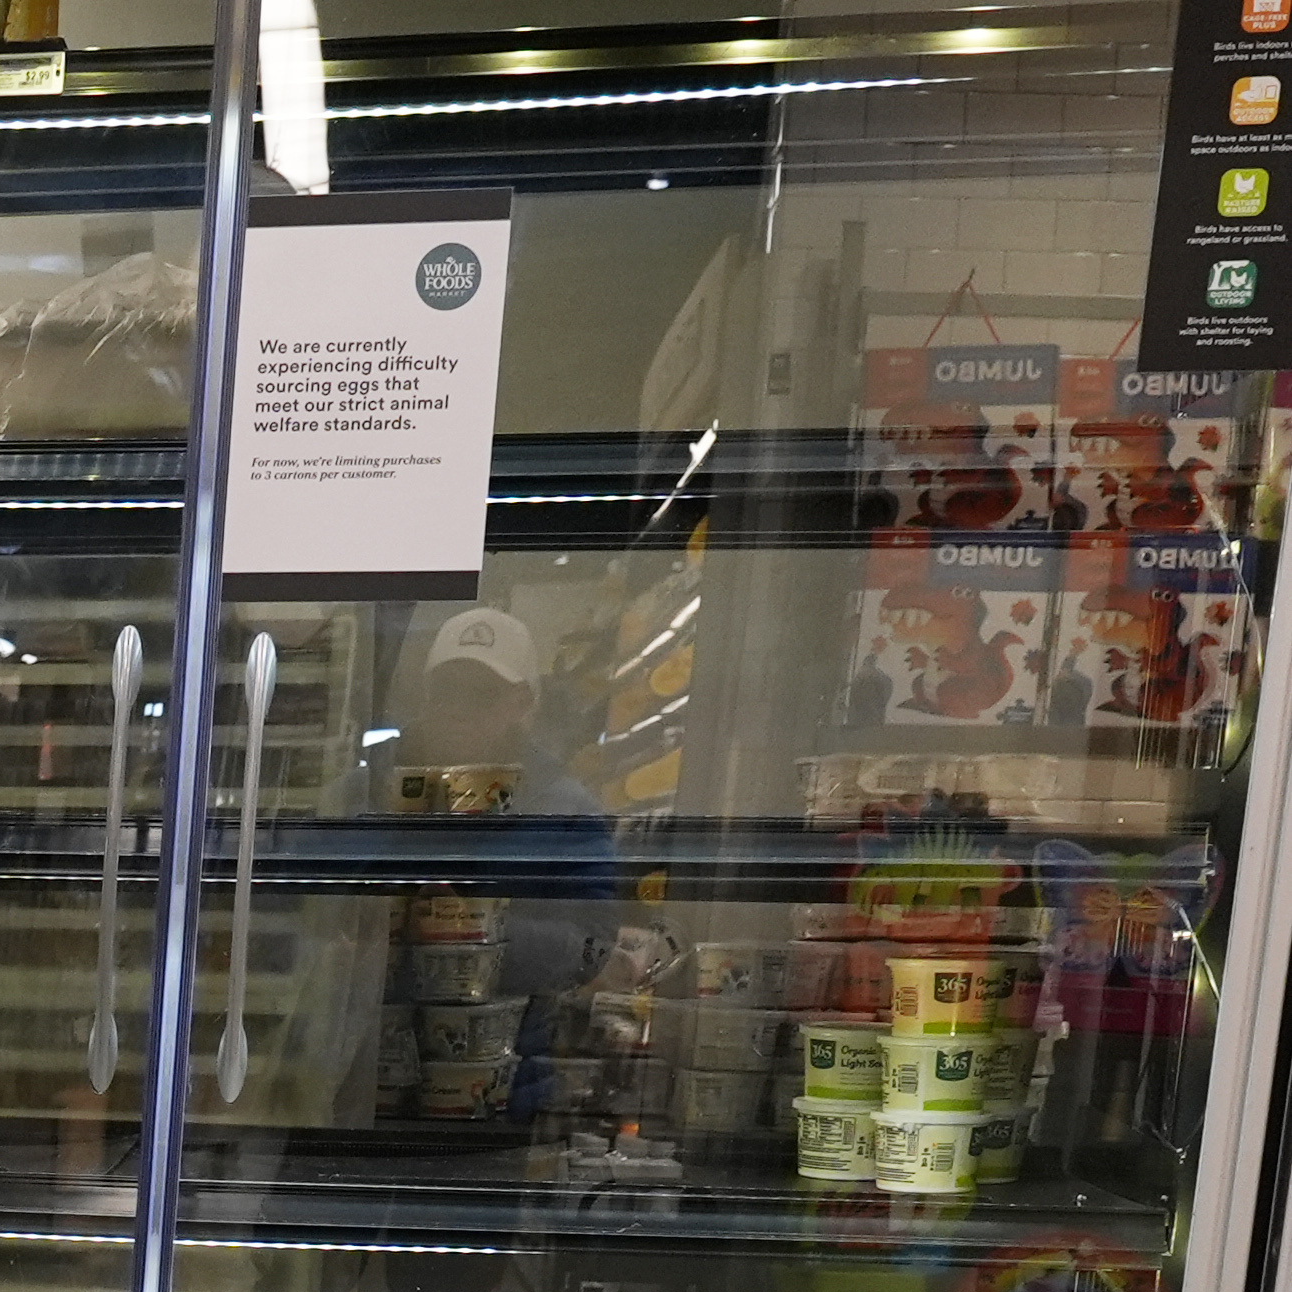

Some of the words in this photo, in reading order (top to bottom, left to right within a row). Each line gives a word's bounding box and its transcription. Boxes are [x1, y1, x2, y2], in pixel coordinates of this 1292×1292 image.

[1195, 225, 1217, 233] Birds
[1219, 225, 1239, 233] have
[1274, 224, 1283, 232] to
[423, 258, 475, 276] WHOLE
[424, 276, 473, 290] FOODS
[1210, 290, 1251, 298] OUTDOOR
[1187, 316, 1209, 325] Birds
[1211, 316, 1227, 324] live
[1229, 316, 1268, 324] outdoors
[1179, 328, 1198, 336] with
[1200, 327, 1229, 335] shelter
[1232, 326, 1245, 334] for
[1247, 326, 1274, 337] laying
[260, 339, 287, 354] We
[293, 341, 320, 353] are
[326, 337, 407, 354] currently
[1196, 338, 1212, 346] and
[257, 358, 372, 376] experiencing
[378, 355, 458, 373] difficulty
[256, 378, 331, 395] sourcing
[337, 379, 379, 395] eggs
[385, 376, 419, 391] that
[255, 399, 299, 412] meet
[304, 400, 334, 412] our
[338, 396, 384, 411] strict
[390, 395, 449, 410] animal
[254, 417, 318, 432] welfare
[324, 415, 416, 431] standards.
[251, 457, 270, 468] For
[273, 457, 300, 468] now,
[303, 456, 333, 467] we're
[335, 455, 380, 468] limiting
[382, 454, 441, 468] purchases
[250, 470, 262, 480] to
[264, 470, 272, 480] 3
[274, 470, 318, 480] cartons
[319, 470, 340, 482] per
[342, 468, 397, 480] customer.
[937, 978, 968, 993] 365
[811, 1044, 833, 1059] 365
[841, 1045, 877, 1056] Organic
[841, 1058, 866, 1069] Light
[939, 1057, 968, 1071] 365
